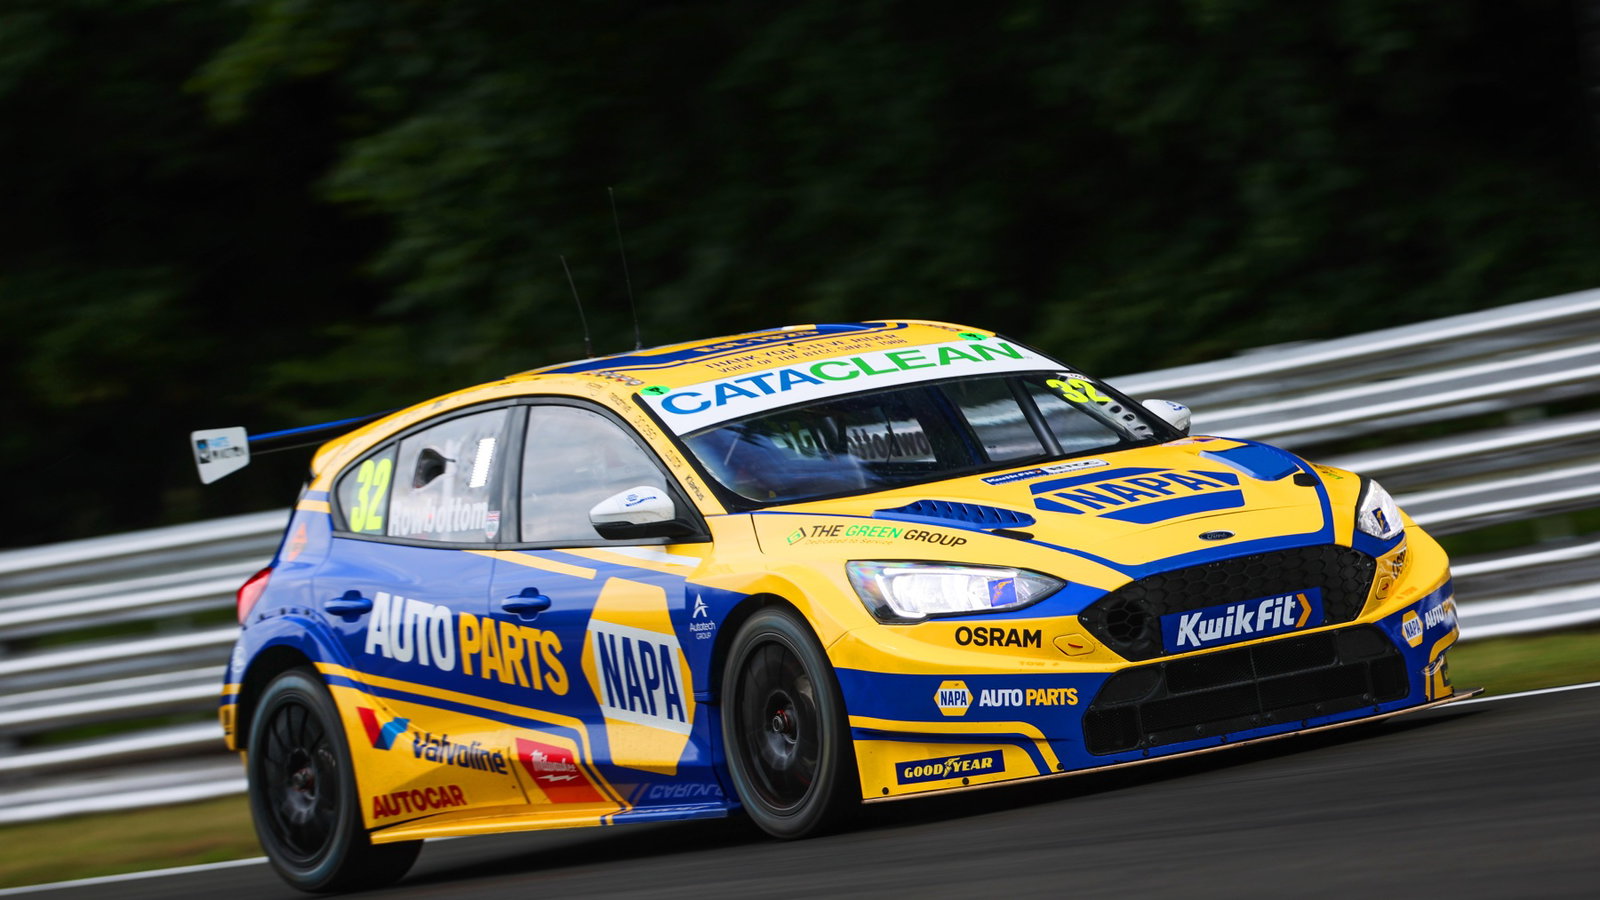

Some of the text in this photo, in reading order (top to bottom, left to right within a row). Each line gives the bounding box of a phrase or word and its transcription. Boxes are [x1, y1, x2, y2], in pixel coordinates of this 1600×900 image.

[705, 355, 755, 369] THANK
[764, 348, 796, 357] YOU
[797, 340, 845, 351] STEVE
[719, 363, 753, 373] VOICE
[837, 343, 872, 351] SINCE
[661, 342, 1024, 415] CATACLEAN
[1046, 379, 1113, 403] 32
[350, 458, 393, 533] 32
[1053, 471, 1224, 509] NAPA
[388, 497, 489, 537] Rowbottom
[810, 524, 968, 547] THE GREEN GROUP
[689, 620, 716, 632] Autotech
[955, 626, 1042, 648] OSRAM
[1404, 617, 1422, 640] NAPA
[1424, 604, 1445, 630] AUTO
[365, 591, 570, 696] AUTO PARTS
[597, 631, 686, 723] NAPA
[940, 690, 967, 706] NAPA
[979, 687, 1079, 707] AUTO PARTS
[411, 731, 509, 775] Valvoline
[373, 784, 468, 820] AUTOCAR
